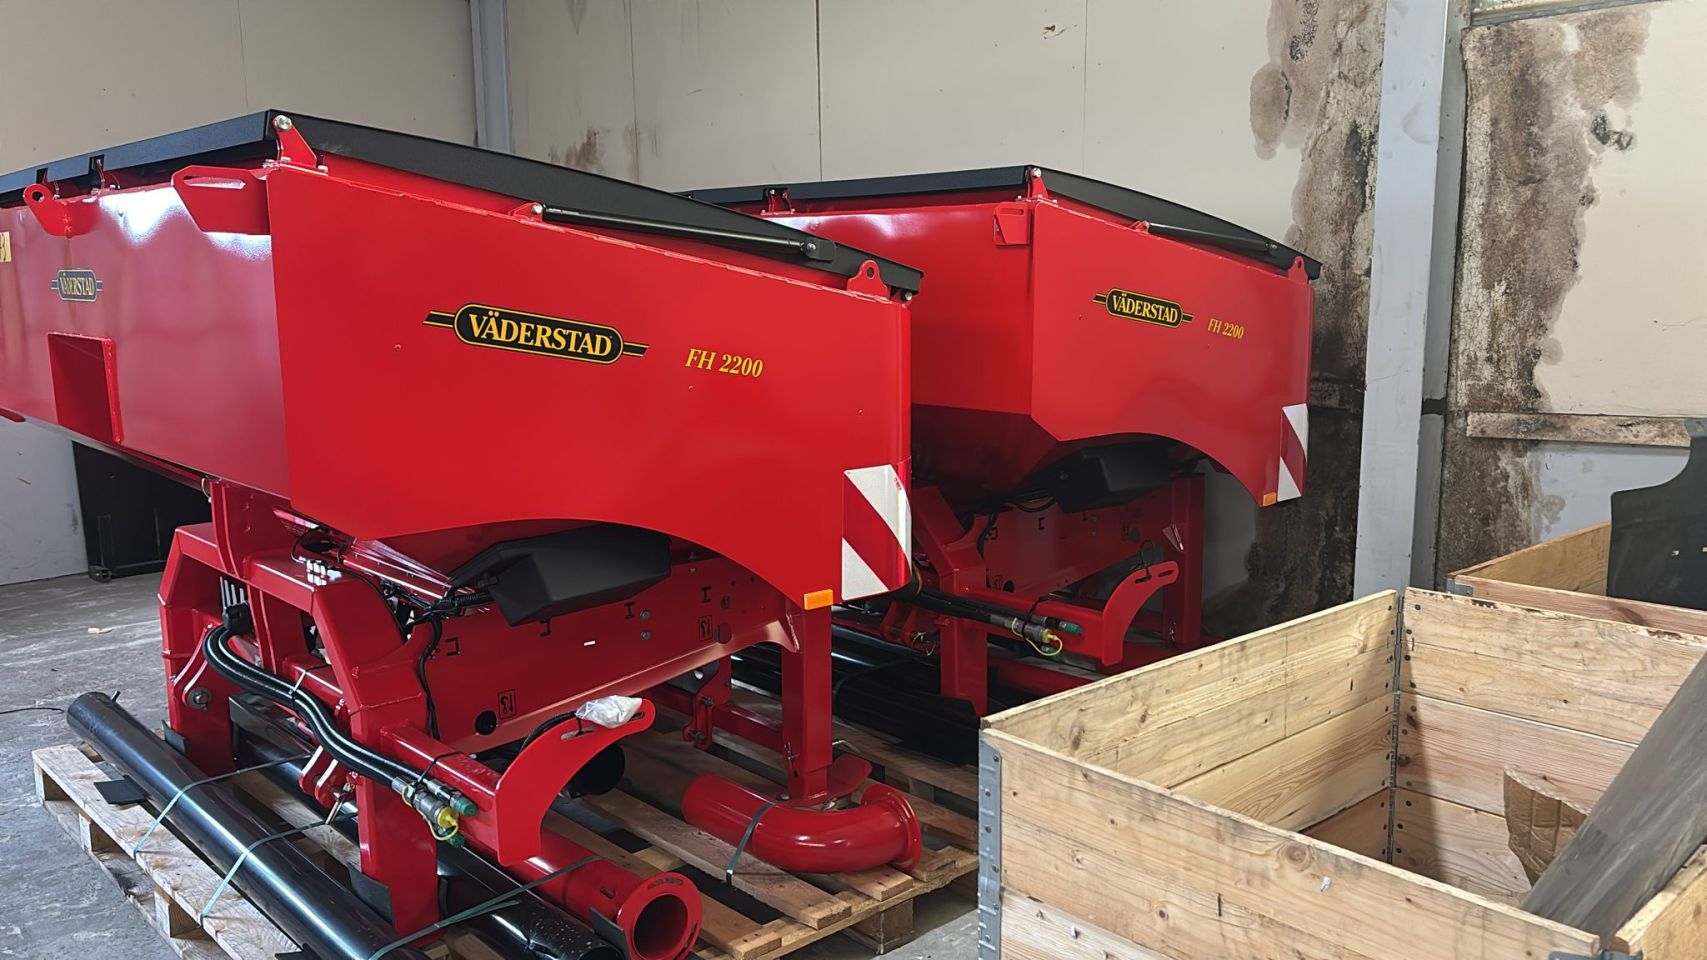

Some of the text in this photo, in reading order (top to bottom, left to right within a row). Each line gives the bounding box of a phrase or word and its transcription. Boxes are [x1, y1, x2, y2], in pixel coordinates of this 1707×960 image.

[1112, 292, 1179, 323] VÄDERSTAD
[468, 310, 613, 357] VÄDERSTAD
[1207, 318, 1245, 340] FH 2200
[685, 348, 763, 378] FH 2200
